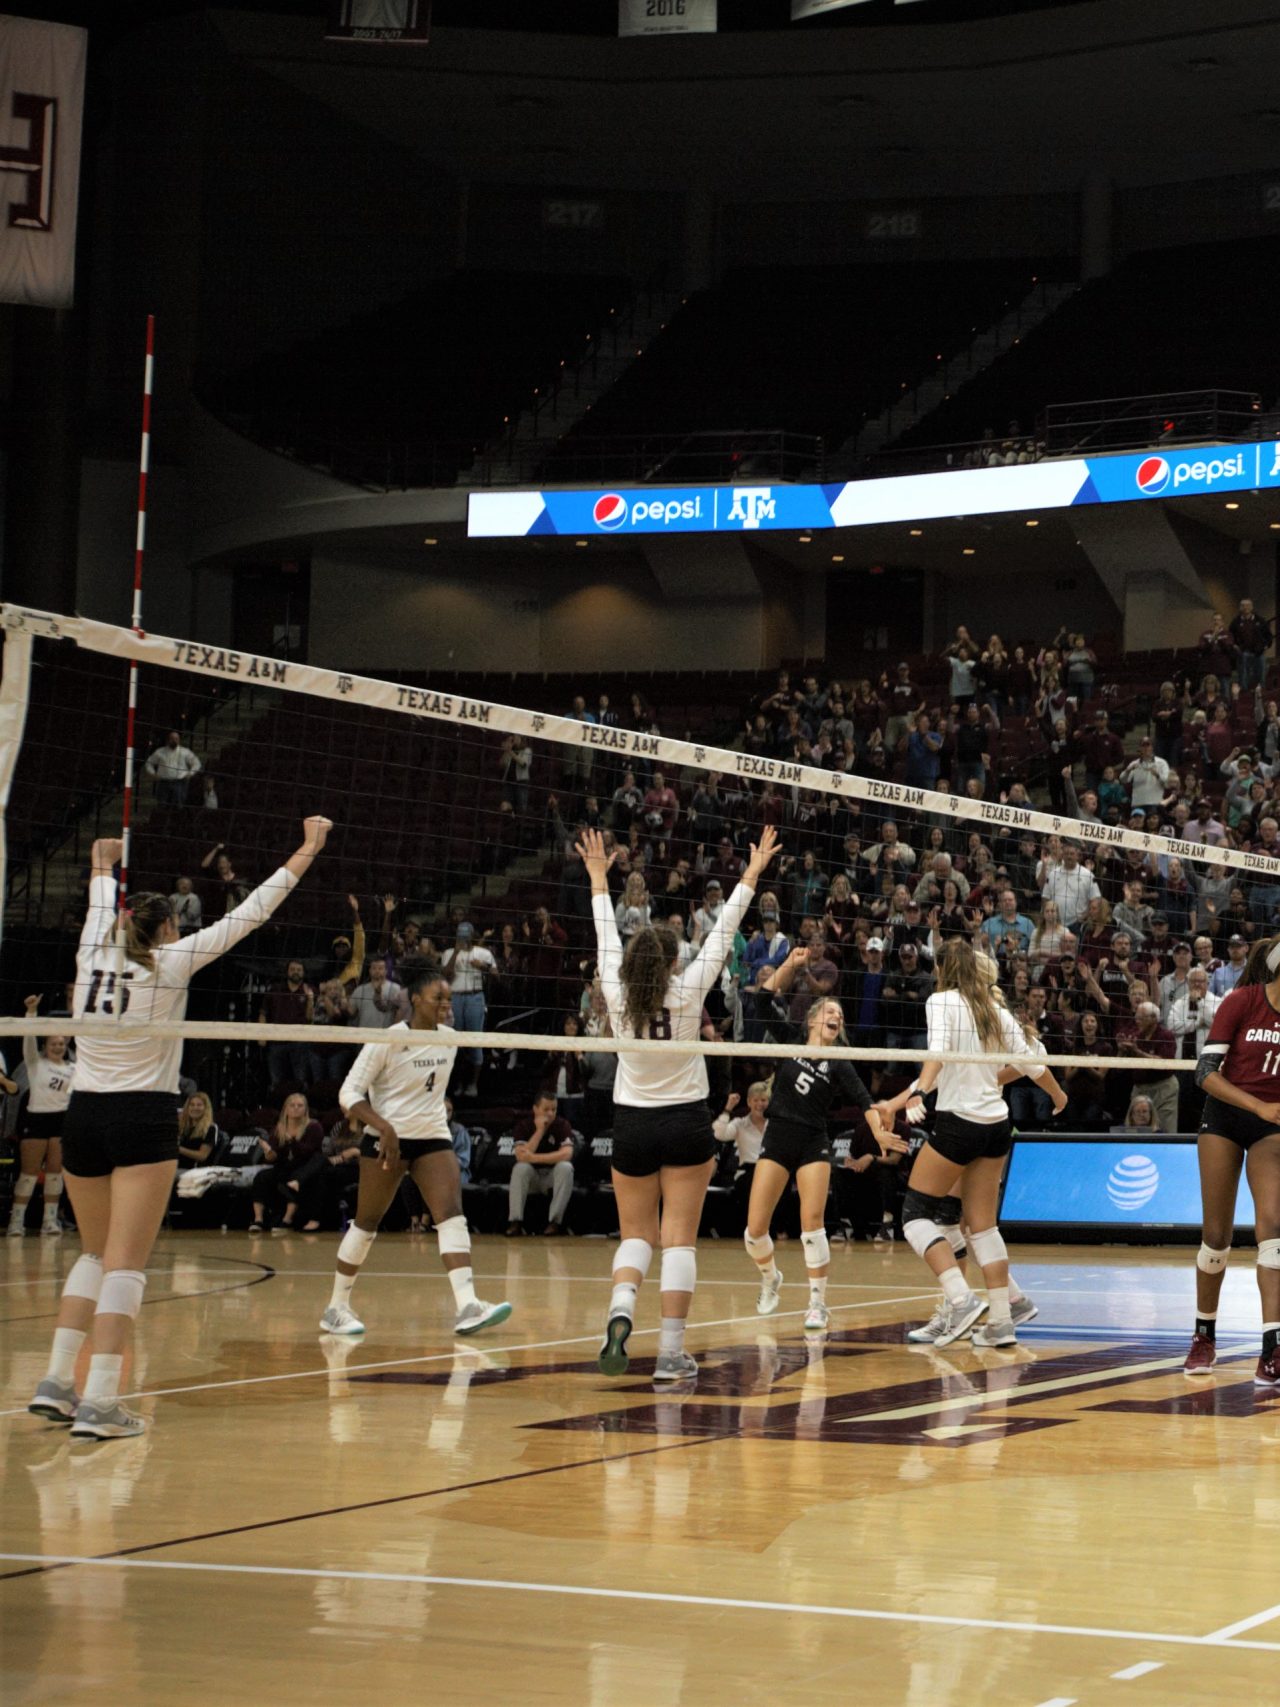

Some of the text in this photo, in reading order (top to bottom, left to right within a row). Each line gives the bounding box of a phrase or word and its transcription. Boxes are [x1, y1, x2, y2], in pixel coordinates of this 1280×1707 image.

[548, 202, 601, 225] 217
[867, 212, 918, 237] 218
[1173, 453, 1243, 487] pepsi
[632, 495, 700, 525] pepsi
[173, 642, 241, 674] TEXAS
[247, 657, 291, 684] A&M
[397, 687, 452, 716] TEXAS
[458, 700, 494, 724] A&M
[581, 724, 627, 750] TEXAS
[632, 735, 660, 757] A&M
[736, 755, 775, 778] TEXAS
[778, 766, 804, 783] A&M
[867, 781, 902, 801] TEXAS
[904, 792, 926, 806] A&M
[980, 803, 1010, 821] TEXAS
[1012, 812, 1033, 826] A&M
[1080, 823, 1106, 840] TEXAS
[1107, 829, 1125, 843] A&M
[1167, 839, 1191, 856] TEXAS
[1243, 854, 1265, 870] TEXAS
[84, 969, 133, 1015] 15
[413, 1060, 435, 1069] TEXAS
[49, 1077, 64, 1092] 21
[425, 1071, 436, 1092] 4
[794, 1071, 815, 1096] 5
